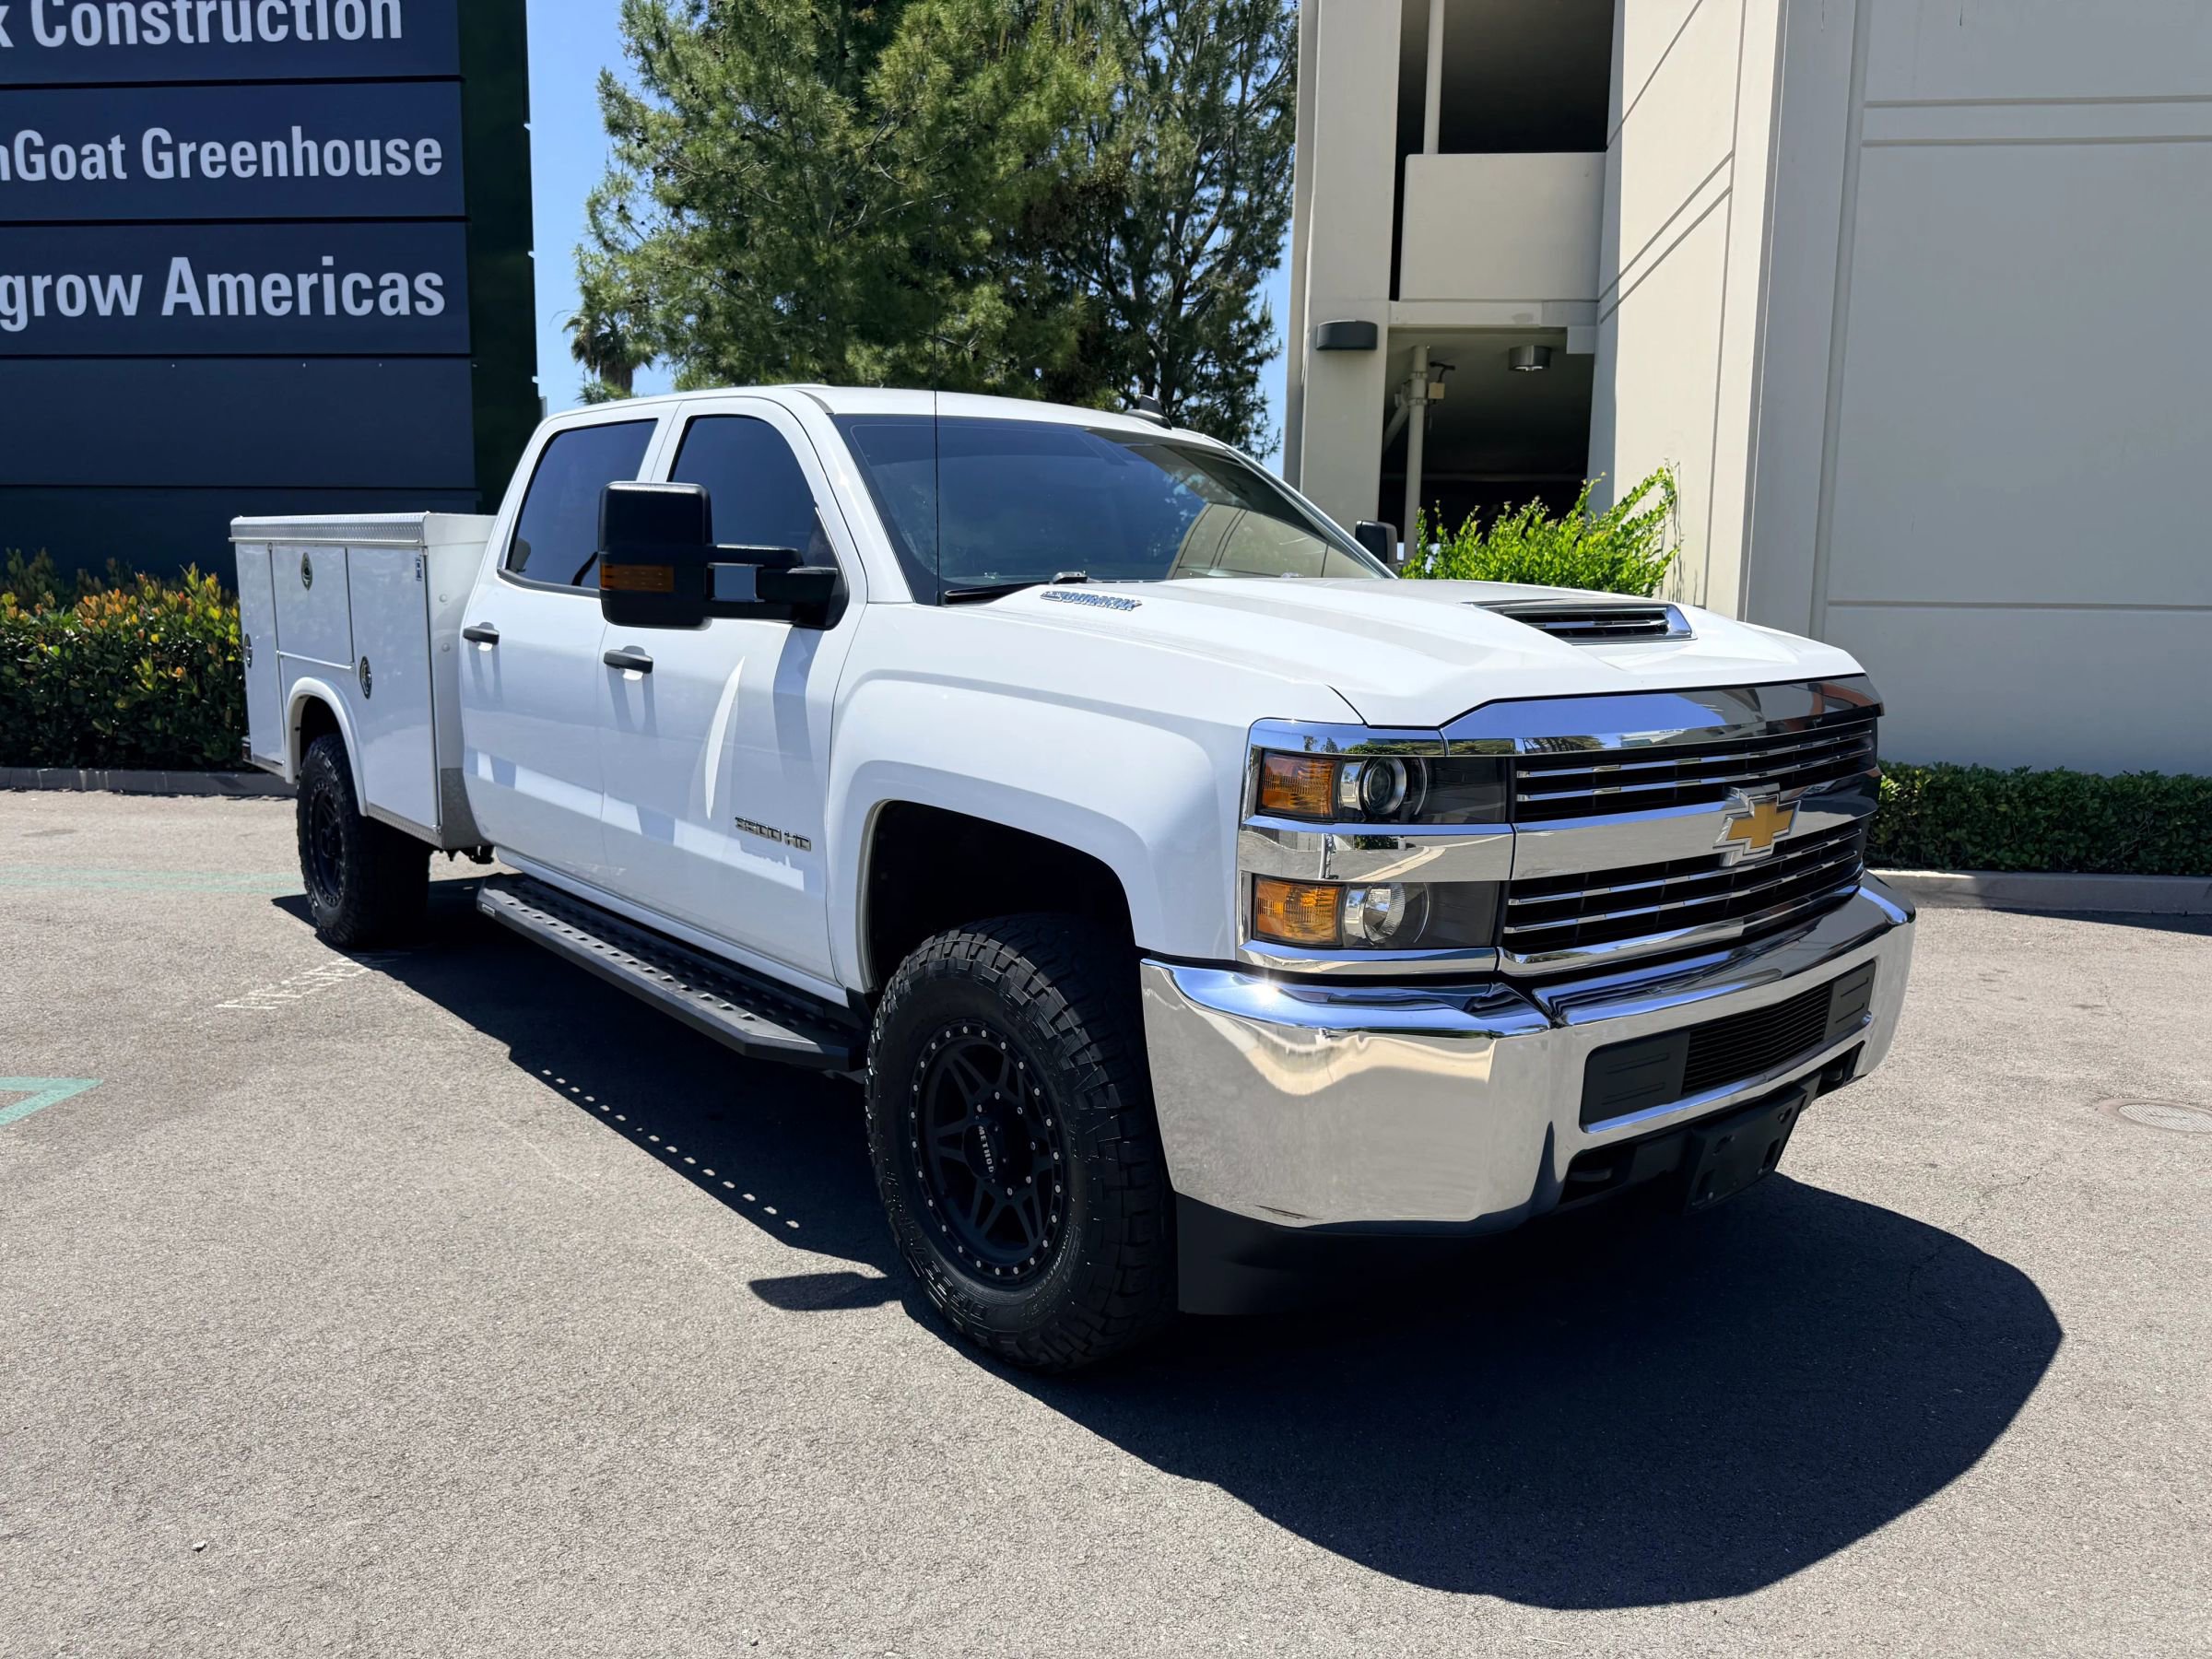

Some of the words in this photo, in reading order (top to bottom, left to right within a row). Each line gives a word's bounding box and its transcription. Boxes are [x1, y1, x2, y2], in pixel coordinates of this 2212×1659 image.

[31, 0, 402, 47] Construction
[142, 125, 442, 179] Greenhouse
[0, 273, 142, 332] grow
[161, 256, 445, 316] Americas
[977, 1124, 995, 1173] METHOD
